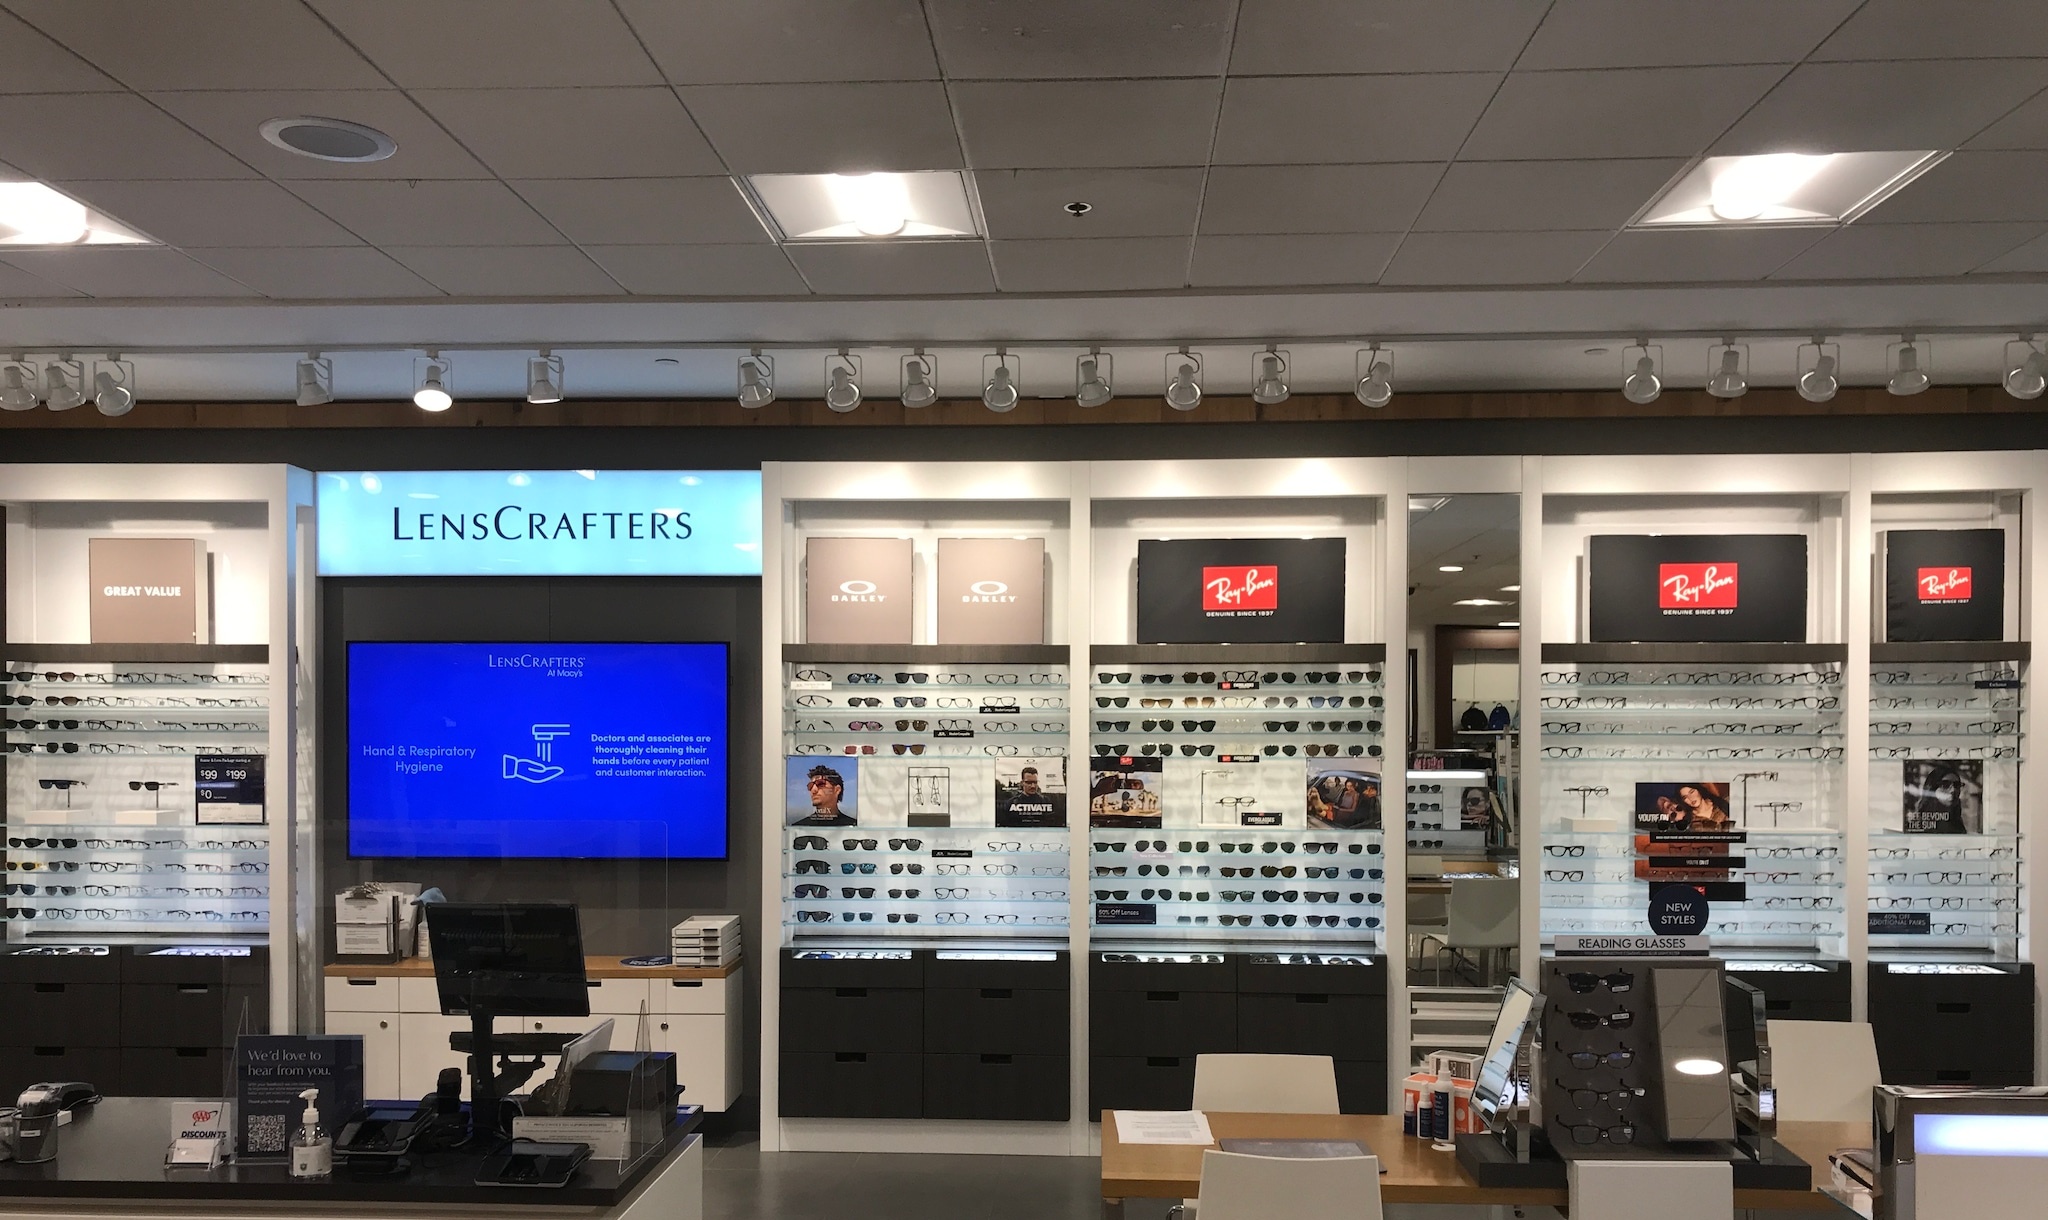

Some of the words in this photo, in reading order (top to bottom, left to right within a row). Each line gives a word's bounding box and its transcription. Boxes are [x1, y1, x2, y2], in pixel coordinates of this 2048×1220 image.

[1206, 569, 1274, 604] Ray-Ban
[1663, 566, 1734, 602] Ray-Ban
[1921, 569, 1968, 595] Ray-Ban
[103, 586, 141, 596] GREAT
[144, 586, 181, 596] VALUE
[962, 595, 1017, 603] OAKLEY
[547, 669, 556, 677] At
[557, 669, 583, 678] Macy's
[591, 734, 625, 743] Doctors
[627, 734, 645, 743] and
[647, 734, 693, 743] associates
[363, 746, 396, 757] Hand
[398, 746, 407, 757] &
[409, 746, 476, 759] Respiratory
[595, 746, 644, 755] thoroughly
[645, 746, 685, 755] cleaning
[687, 746, 707, 754] their
[395, 761, 443, 773] Hygiene
[592, 757, 620, 765] hands
[621, 757, 651, 765] before
[652, 759, 677, 767] every
[679, 757, 710, 767] patient
[200, 769, 218, 780] $99
[226, 769, 247, 780] $199
[595, 768, 612, 777] and
[614, 769, 656, 777] customer
[657, 768, 706, 777] interaction.
[200, 789, 212, 799] $0
[1009, 803, 1053, 811] ACTIVATE
[1922, 812, 1950, 821] BEYOND
[1908, 821, 1920, 829] THE
[1922, 821, 1937, 829] SUN
[1665, 903, 1692, 912] NEW
[1660, 915, 1696, 925] STYLES
[1578, 938, 1632, 949] READING
[1635, 938, 1686, 949] GLASSES
[248, 1049, 280, 1060] We'd
[282, 1049, 307, 1060] love
[309, 1051, 322, 1060] to
[248, 1064, 272, 1075] hear
[277, 1064, 304, 1075] from
[307, 1067, 331, 1077] you.
